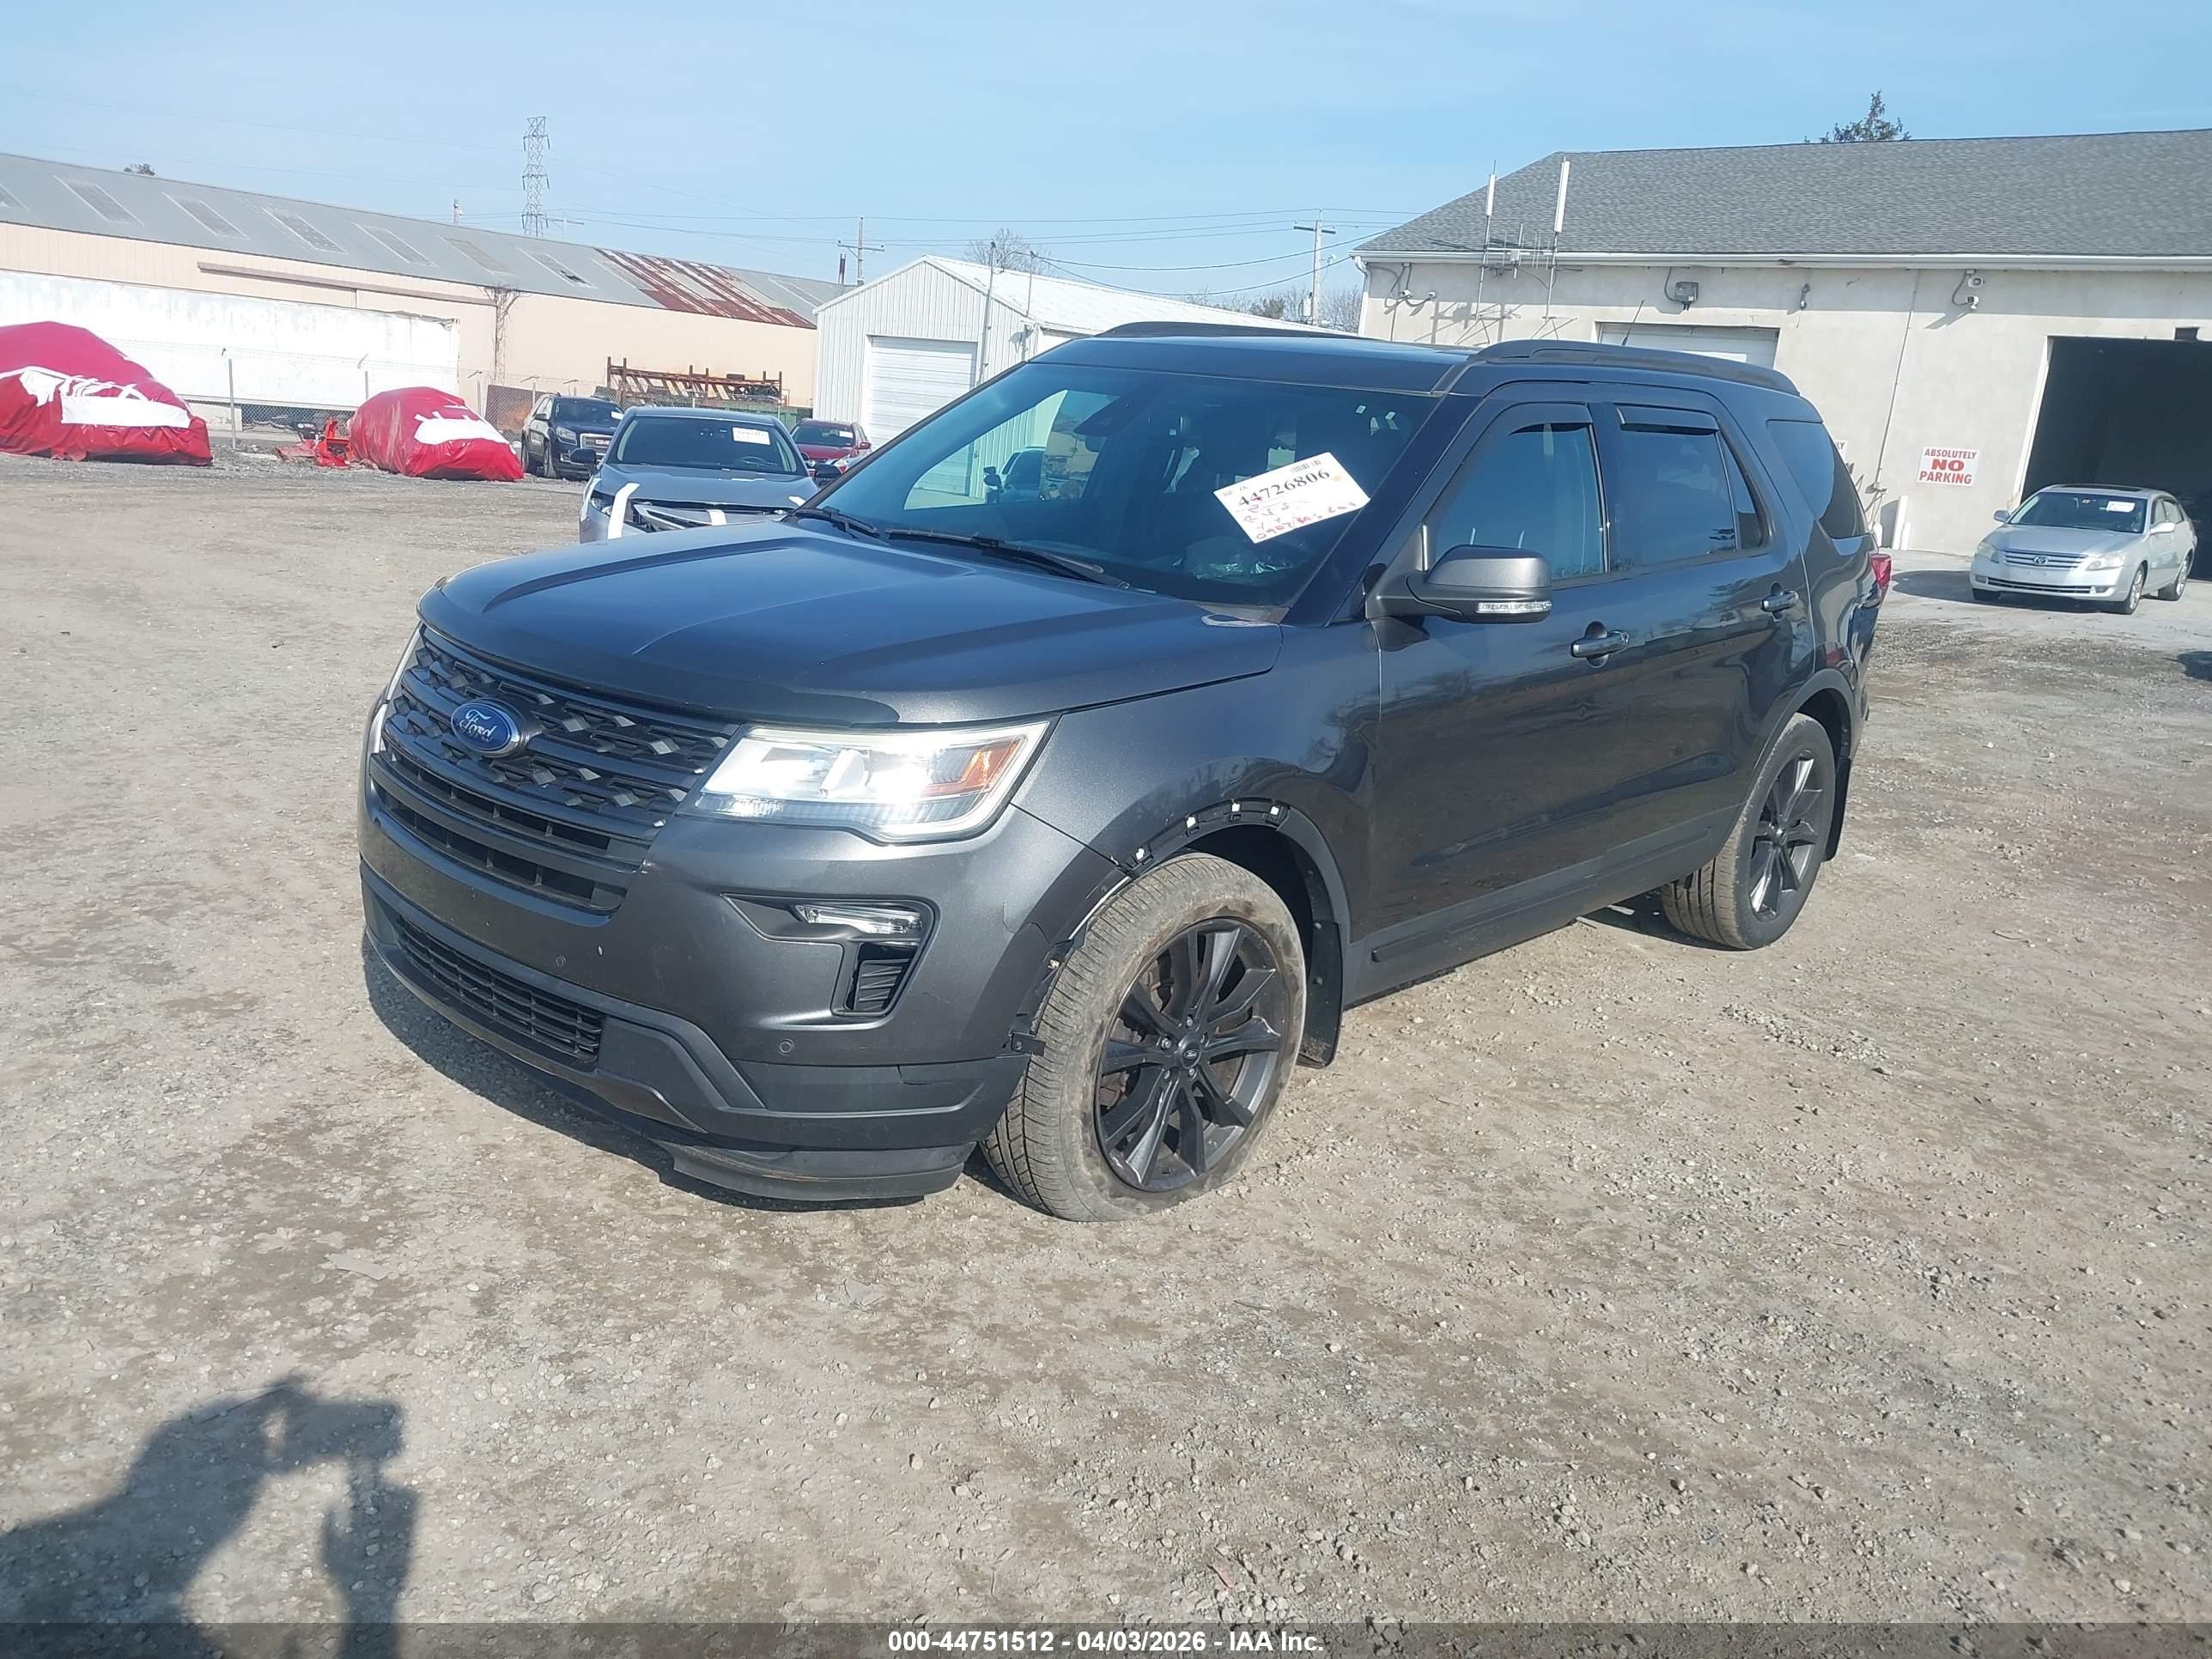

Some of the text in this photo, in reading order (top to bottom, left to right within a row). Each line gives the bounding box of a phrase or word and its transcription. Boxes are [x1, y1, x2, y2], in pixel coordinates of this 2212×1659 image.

[1924, 448, 1978, 459] ABSOLUTELY
[1930, 459, 1965, 471] NO
[1918, 471, 1972, 484] PARKING
[1238, 469, 1330, 506] 44726806
[459, 708, 498, 738] Ford
